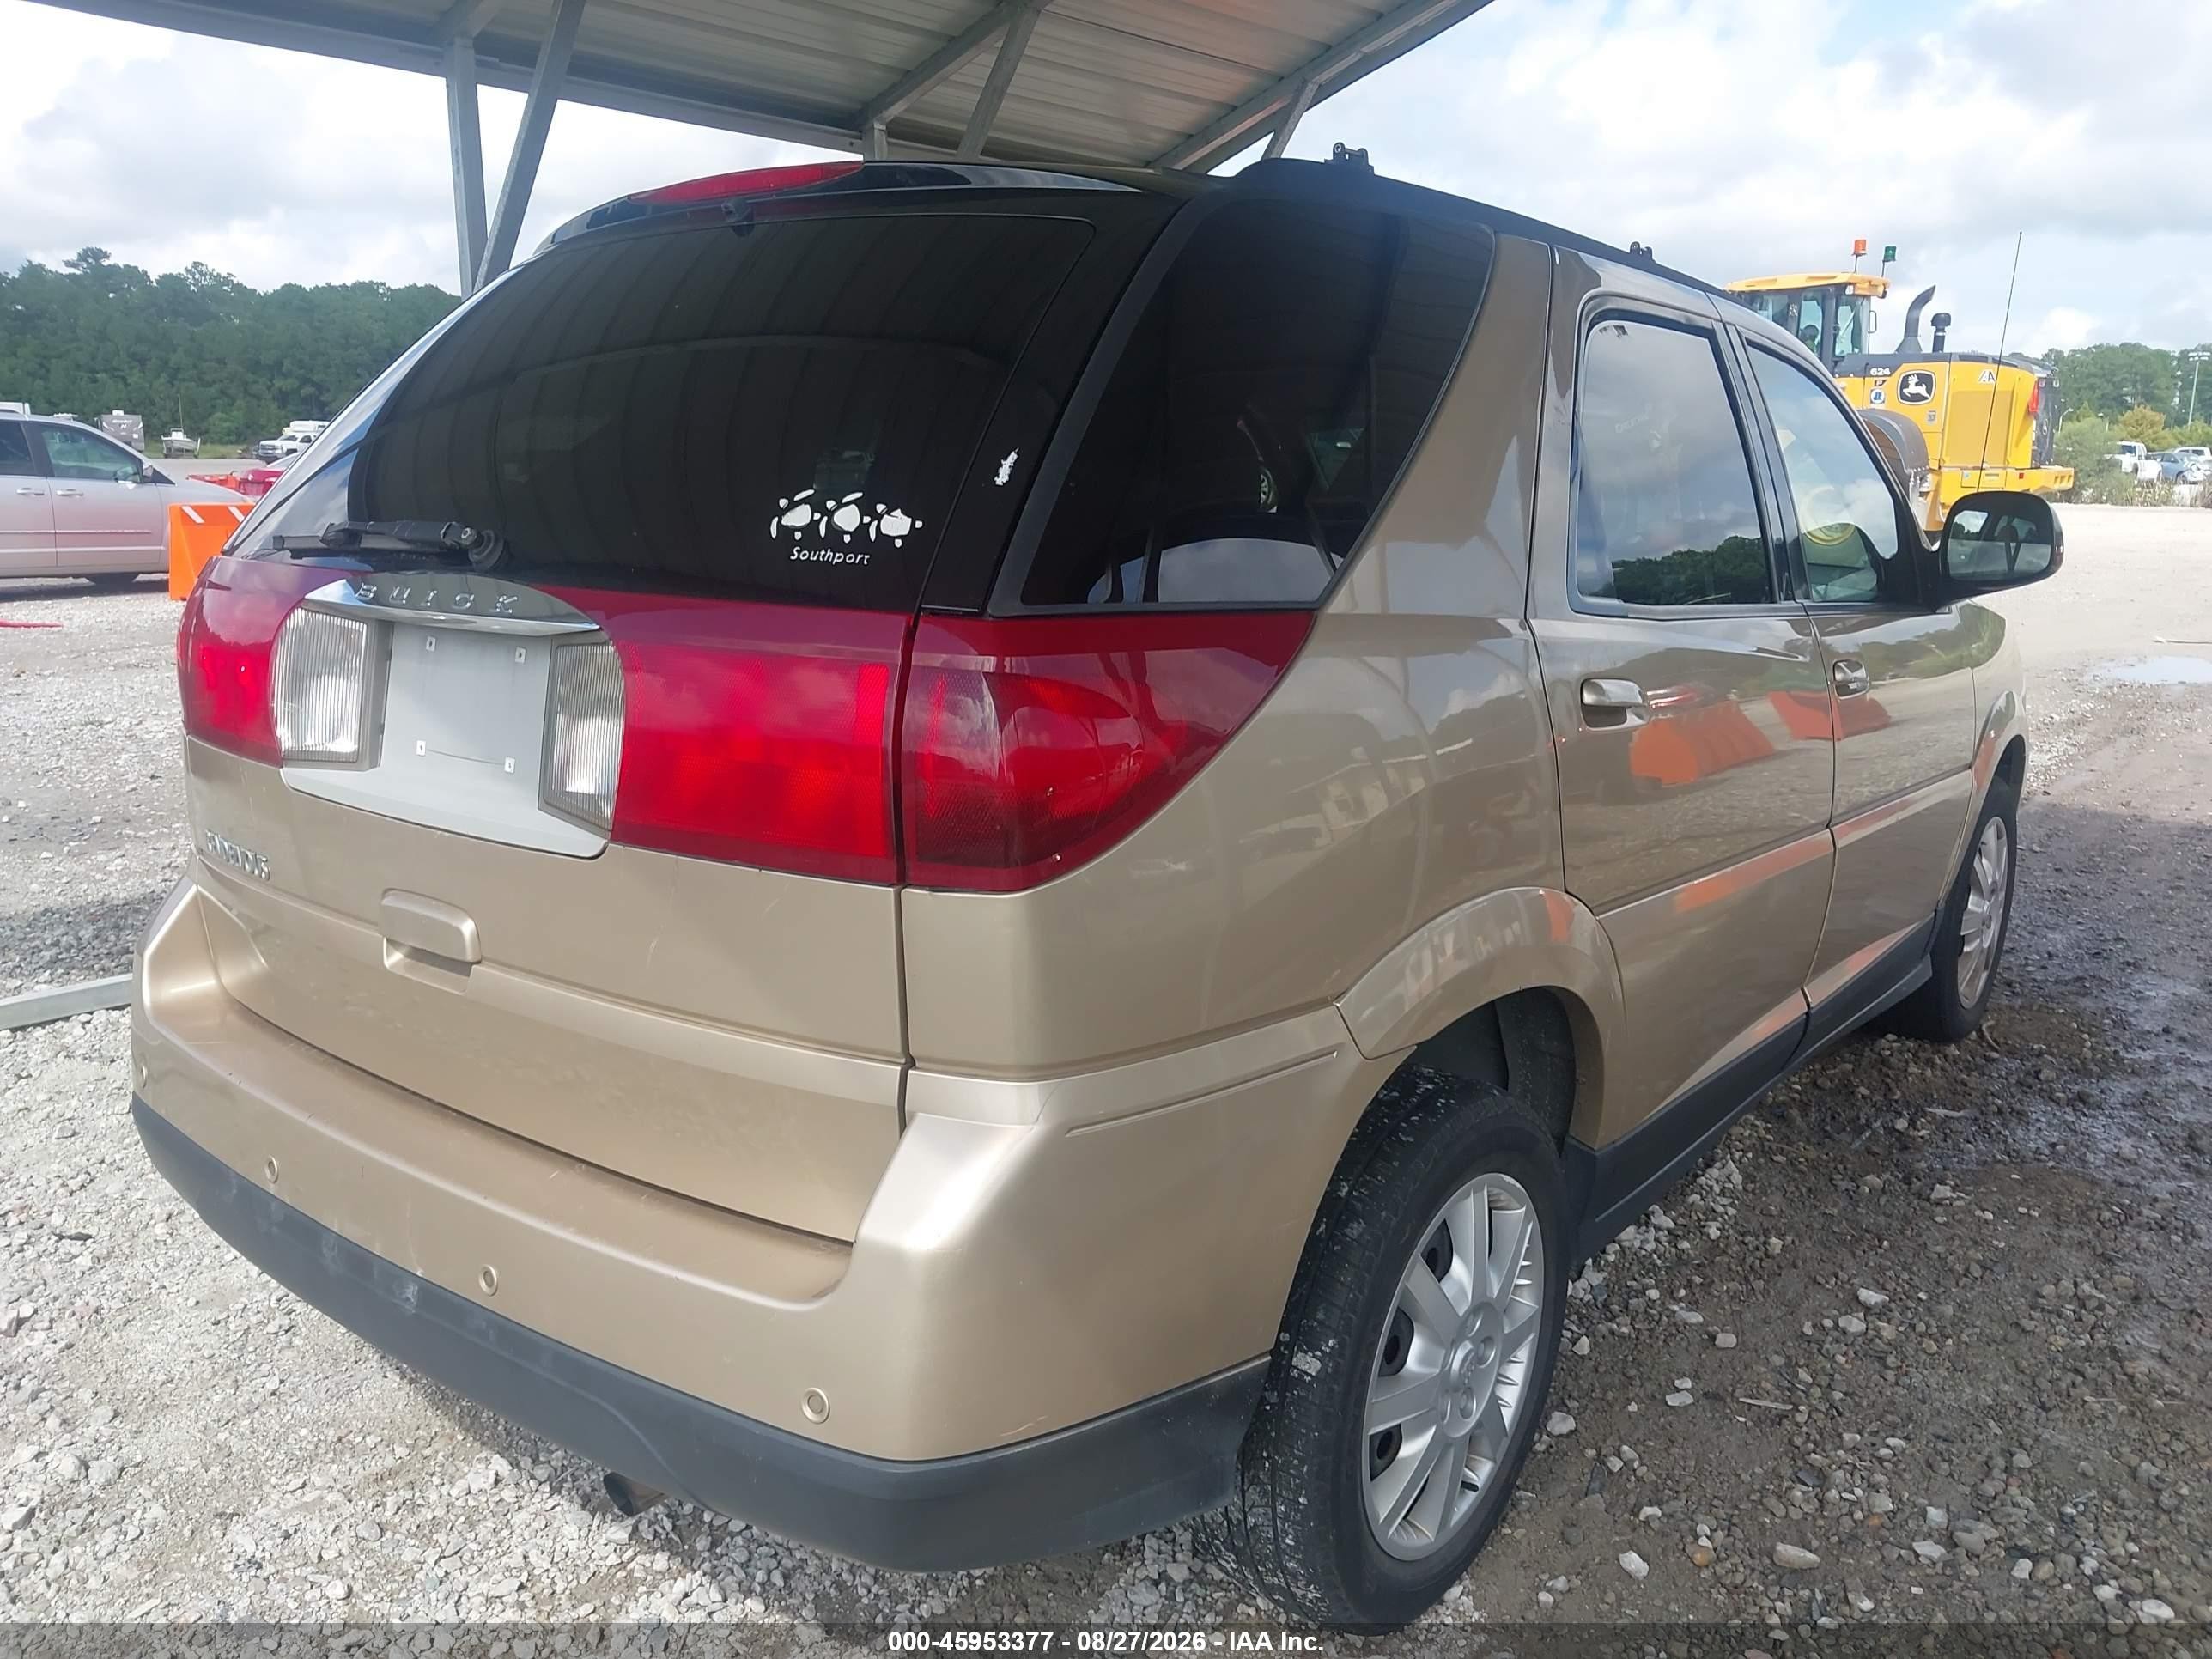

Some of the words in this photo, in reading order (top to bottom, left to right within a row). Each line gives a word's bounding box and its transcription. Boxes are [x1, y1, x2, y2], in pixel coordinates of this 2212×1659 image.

[1869, 367, 1891, 376] 624
[789, 545, 871, 566] Southport
[355, 581, 519, 614] BUICK
